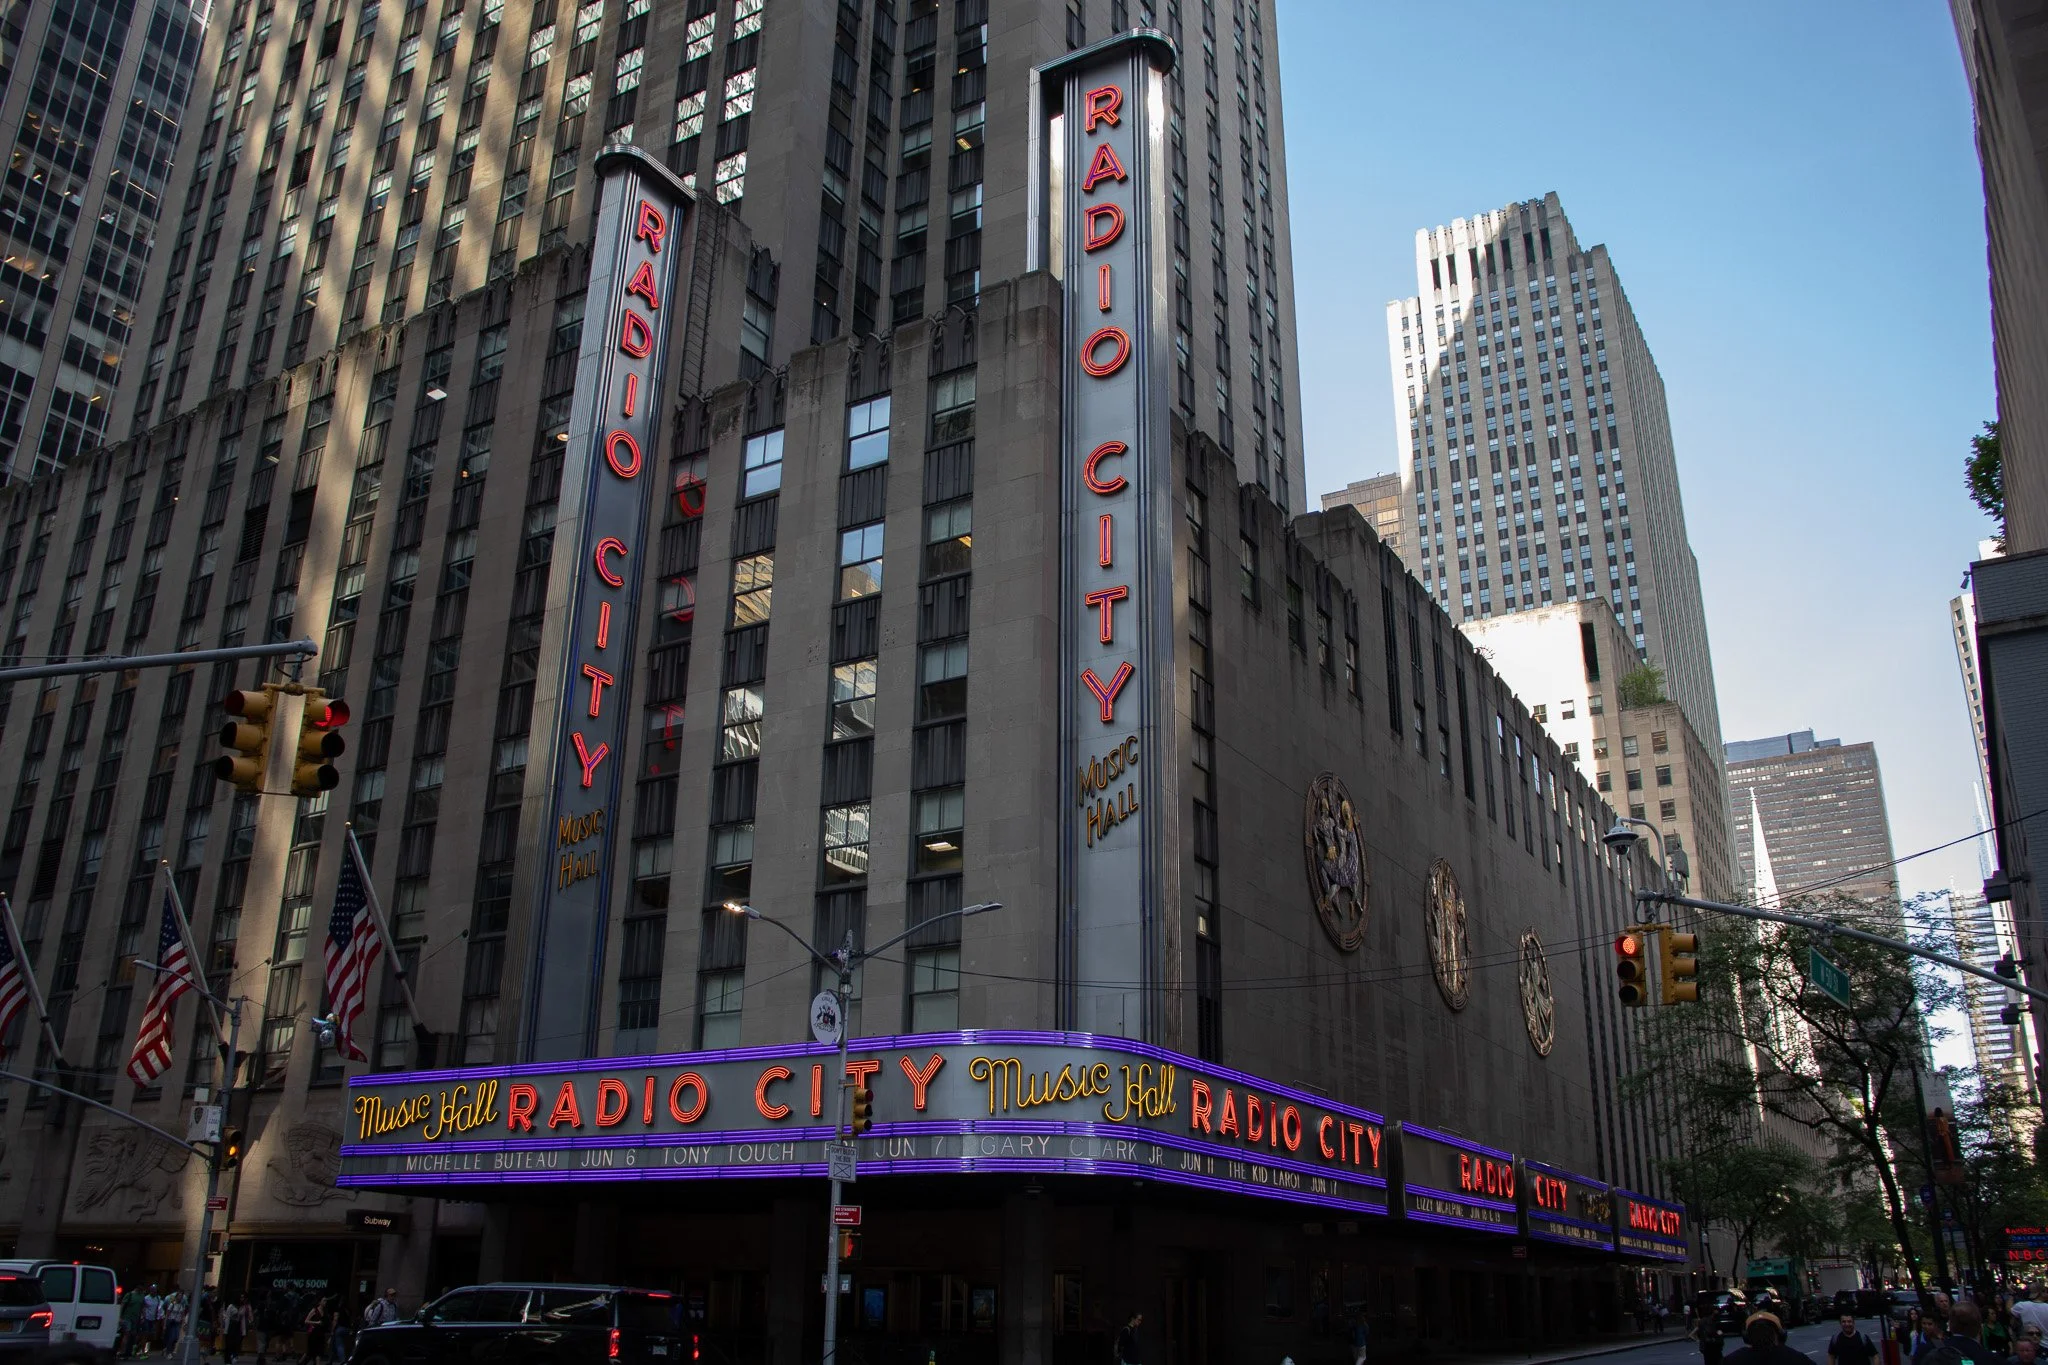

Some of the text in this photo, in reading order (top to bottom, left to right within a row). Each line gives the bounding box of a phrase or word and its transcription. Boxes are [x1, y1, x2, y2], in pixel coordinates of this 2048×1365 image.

[1080, 83, 1136, 723] RADIO CITY
[571, 199, 667, 788] RADIO CITY
[1079, 735, 1138, 807] MUSIC
[557, 809, 603, 851] MUSIC
[1087, 783, 1138, 848] HALL
[558, 851, 598, 892] HALL
[353, 1052, 1382, 1169] Music Hall RADIO CITY Music Hall RADIO CITY
[406, 1152, 482, 1171] MICHELLE
[494, 1150, 558, 1169] BUTEAU
[581, 1149, 613, 1167] JUN
[626, 1148, 636, 1166] 6
[663, 1145, 712, 1165] TONY
[728, 1142, 795, 1163] TOUCH
[875, 1137, 915, 1158] JUN
[934, 1136, 945, 1156] 7
[980, 1136, 1051, 1156] GARY
[1069, 1138, 1138, 1161] CLARK
[1180, 1152, 1201, 1172] JUN
[1228, 1161, 1247, 1180] THE
[1252, 1166, 1268, 1183] KID
[1273, 1169, 1300, 1189] LAROI
[1311, 1176, 1326, 1194] JUN
[1461, 1154, 1515, 1199] RADIO
[1536, 1175, 1568, 1212] CITY
[364, 1216, 391, 1227] Subway
[1416, 1196, 1433, 1212] LIZZY
[1629, 1201, 1658, 1232] RADIO
[1661, 1209, 1680, 1237] CITY
[2008, 1249, 2045, 1261] NBC
[306, 1279, 328, 1288] SOON
